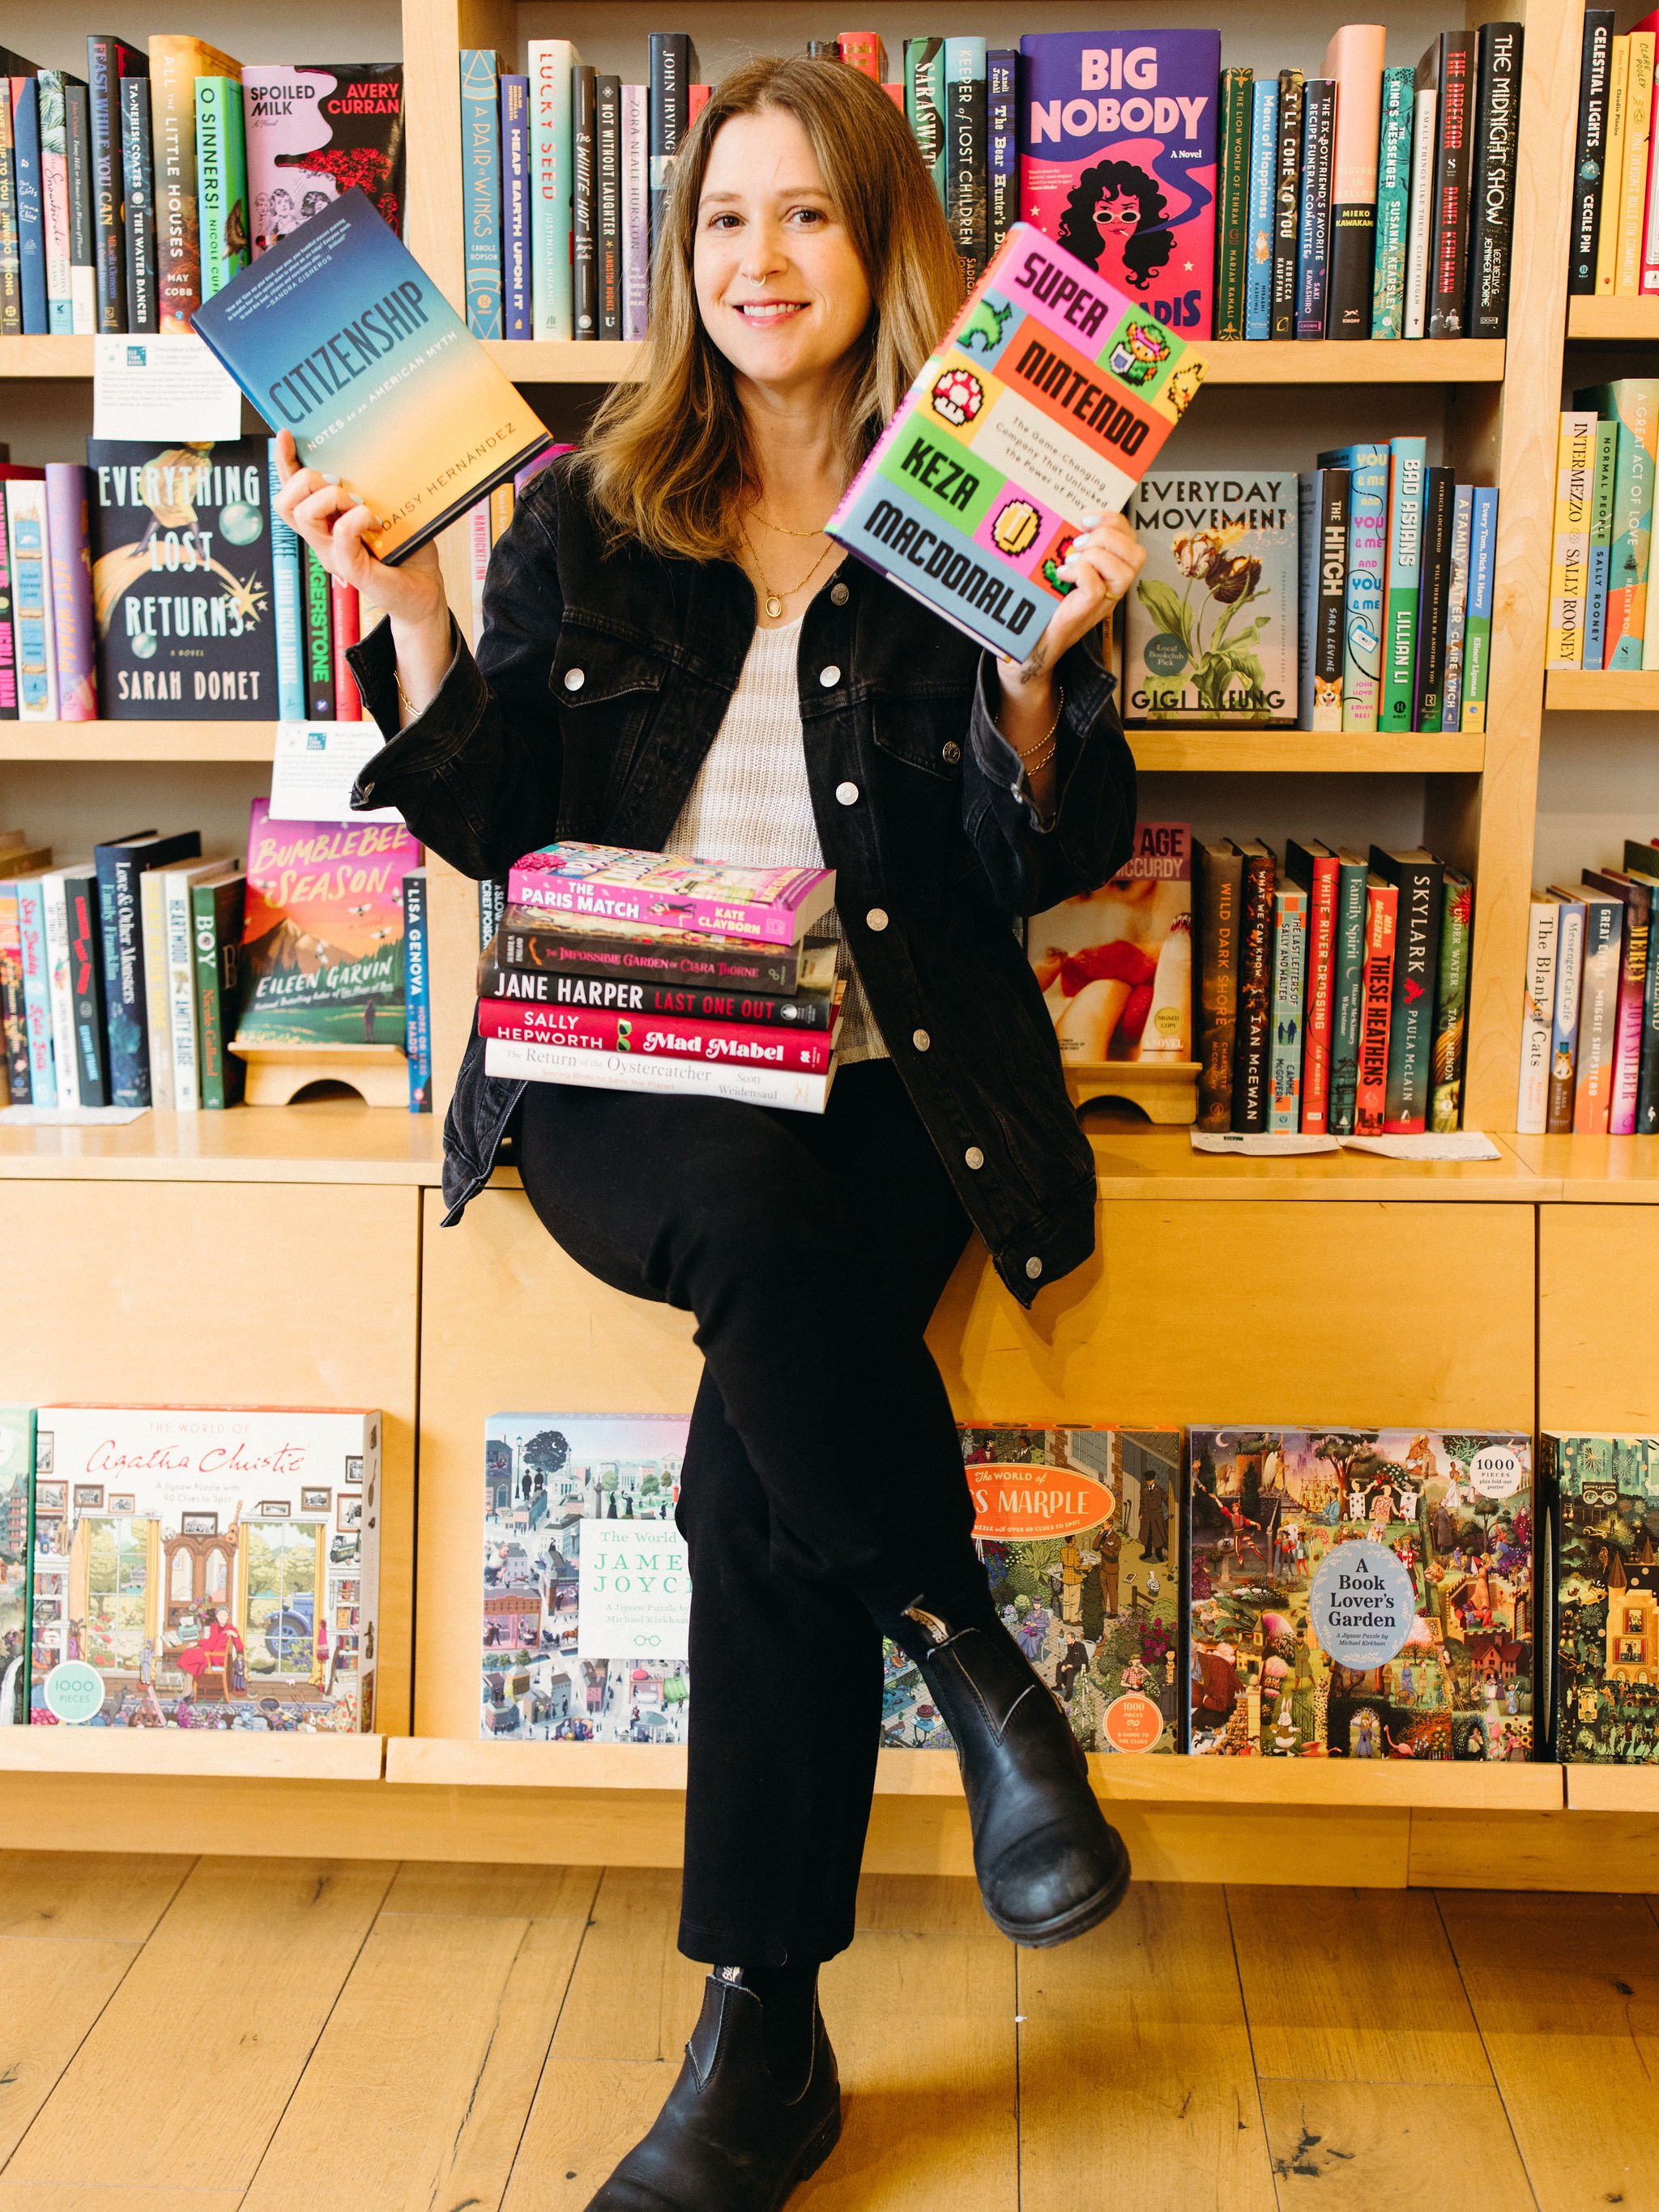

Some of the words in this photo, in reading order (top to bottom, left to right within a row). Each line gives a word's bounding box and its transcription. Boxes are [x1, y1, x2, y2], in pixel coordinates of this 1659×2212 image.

[663, 49, 675, 91] JOHN
[1081, 46, 1158, 92] BIG
[1494, 34, 1512, 72] THE
[1591, 27, 1606, 95] CELESTIAL
[251, 85, 315, 100] SPOILED
[347, 83, 399, 98] AVERY
[539, 53, 555, 130] LUCKY
[958, 49, 973, 103] KEEPER
[251, 101, 292, 116] MILK
[327, 99, 399, 115] CURRAN
[663, 96, 676, 151] IRVING
[995, 105, 1007, 131] The
[1030, 96, 1208, 144] NOBODY
[1489, 78, 1511, 164] MIDNIGHT
[1587, 100, 1601, 147] LIGHTS
[165, 117, 180, 177] LITTLE
[202, 113, 220, 210] SINNERS!
[602, 130, 615, 177] WITHOUT
[959, 121, 973, 165] LOST
[995, 136, 1007, 167] Bear
[1179, 150, 1202, 159] Novel
[1283, 139, 1296, 176] COME
[98, 155, 112, 187] YOU
[131, 143, 142, 188] COATES
[541, 143, 557, 199] SEED
[472, 177, 492, 237] WINGS
[603, 181, 615, 236] LAUGHTER
[959, 169, 973, 247] CHILDREN
[995, 173, 1007, 226] Hunter's
[1486, 168, 1504, 225] SHOW
[1582, 195, 1593, 232] CECILE
[168, 185, 183, 258] HOUSES
[1281, 211, 1294, 239] YOU
[134, 237, 145, 276] WATER
[137, 279, 147, 324] DANCER
[1014, 253, 1108, 337] SUPER
[269, 280, 429, 424] CITIZENSHIP
[307, 419, 344, 451] NOTES
[369, 353, 425, 404] AMERICAN
[425, 330, 458, 360] MYTH
[1015, 339, 1150, 457] NINTENDO
[995, 422, 1038, 454] Company
[1041, 450, 1062, 473] That
[1064, 466, 1108, 509] Unlocked
[1013, 416, 1030, 433] The
[1033, 428, 1107, 492] Game-Changing
[1357, 454, 1388, 467] YOU
[1569, 423, 1588, 522] INTERMEZZO
[1601, 437, 1610, 488] NORMAL
[98, 466, 260, 507] EVERYTHING
[901, 437, 979, 512] KEZA
[1005, 446, 1019, 459] the
[1021, 454, 1054, 482] Power
[1066, 488, 1086, 512] Play
[1141, 481, 1282, 503] EVERYDAY
[1405, 458, 1421, 495] BAD
[382, 495, 422, 532] DAISY
[1136, 509, 1286, 530] MOVEMENT
[1354, 517, 1384, 529] YOU
[1597, 495, 1607, 539] PEOPLE
[150, 532, 213, 572] LOST
[1399, 500, 1418, 568] ASIANS
[863, 500, 1037, 637] MACDONALD
[1324, 526, 1345, 596] HITCH
[1564, 549, 1580, 596] SALLY
[1595, 552, 1603, 586] SALLY
[1352, 578, 1380, 590] YOU
[126, 596, 244, 637] RETURNS
[1560, 600, 1576, 661] ROONEY
[1592, 594, 1601, 641] ROONEY
[1149, 651, 1183, 659] Bookclub
[1397, 611, 1412, 665] LILLIAN
[117, 671, 181, 700] SARAH
[194, 671, 259, 700] DOMET
[1132, 690, 1189, 710] GIGI
[1217, 690, 1285, 710] LEUNG
[253, 824, 408, 873] BUMBLEBEE
[1140, 829, 1183, 858] AGE
[267, 863, 391, 907] SEASON
[521, 888, 573, 908] PARIS
[577, 897, 639, 919] MATCH
[569, 881, 594, 895] THE
[697, 917, 761, 935] CLAYBORN
[715, 908, 744, 920] KATE
[1409, 876, 1429, 974] SKYLARK
[196, 915, 215, 968] BOY
[1218, 927, 1230, 969] DARK
[1538, 918, 1553, 949] The
[256, 968, 319, 997] EILEEN
[327, 957, 393, 987] GARVIN
[495, 973, 548, 1000] JANE
[557, 978, 643, 1009] HARPER
[1290, 956, 1299, 992] LETTERS
[1371, 956, 1390, 999] THESE
[1533, 957, 1551, 1025] Blanket
[655, 991, 696, 1011] LAST
[702, 995, 733, 1015] ONE
[741, 999, 774, 1019] OUT
[1216, 974, 1227, 1026] SHORE
[1290, 995, 1298, 1005] OF
[497, 1027, 603, 1049] HEPWORTH
[524, 1012, 578, 1029] SALLY
[1251, 1016, 1260, 1047] IAN
[526, 1047, 577, 1068] Return
[608, 1055, 711, 1081] Oystercatcher
[643, 1031, 701, 1053] Mad
[706, 1038, 783, 1061] Mabel
[1364, 1004, 1387, 1086] HEATHENS
[1530, 1031, 1546, 1068] Cats
[719, 1085, 778, 1100] Weidensaul
[86, 1439, 189, 1477] Agatha
[199, 1443, 306, 1473] Christie
[1478, 1459, 1514, 1471] 1000
[975, 1472, 992, 1482] The
[994, 1473, 1032, 1481] WORLD
[1036, 1473, 1047, 1484] of
[1000, 1491, 1090, 1518] MARPLE
[600, 1532, 629, 1542] The
[635, 1532, 676, 1543] World
[594, 1554, 682, 1571] JAME
[1355, 1558, 1368, 1572] A
[594, 1576, 693, 1593] JOYC
[1331, 1592, 1394, 1609] Lover's
[1338, 1575, 1385, 1590] Book
[1328, 1612, 1396, 1627] Garden
[1382, 1633, 1388, 1641] by
[55, 1681, 94, 1692] 1000
[59, 1694, 90, 1703] PIECES
[1123, 1702, 1145, 1711] 1000
